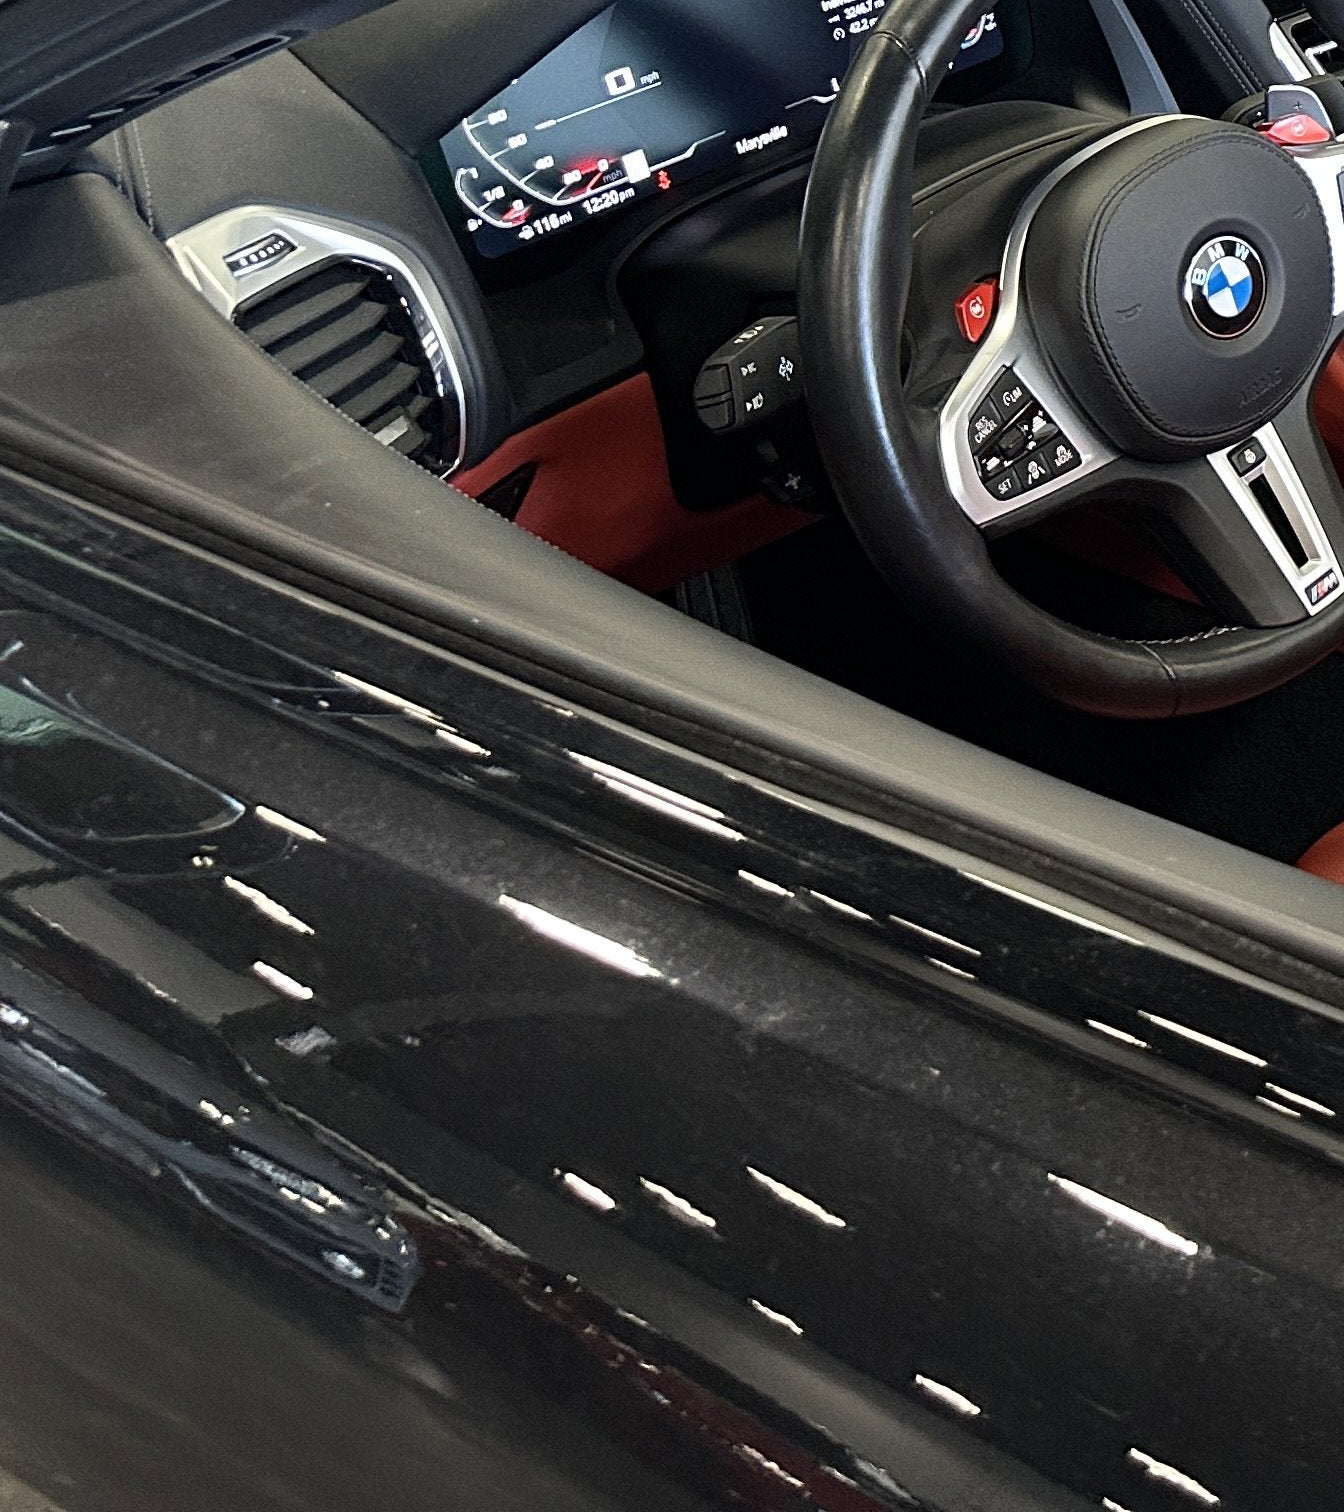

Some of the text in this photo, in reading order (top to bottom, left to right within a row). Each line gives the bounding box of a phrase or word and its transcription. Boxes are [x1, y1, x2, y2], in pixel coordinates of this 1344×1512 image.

[640, 70, 660, 86] mph
[735, 125, 788, 156] Marysville
[602, 168, 623, 184] mph
[1191, 242, 1250, 286] BMW
[998, 477, 1012, 495] SET
